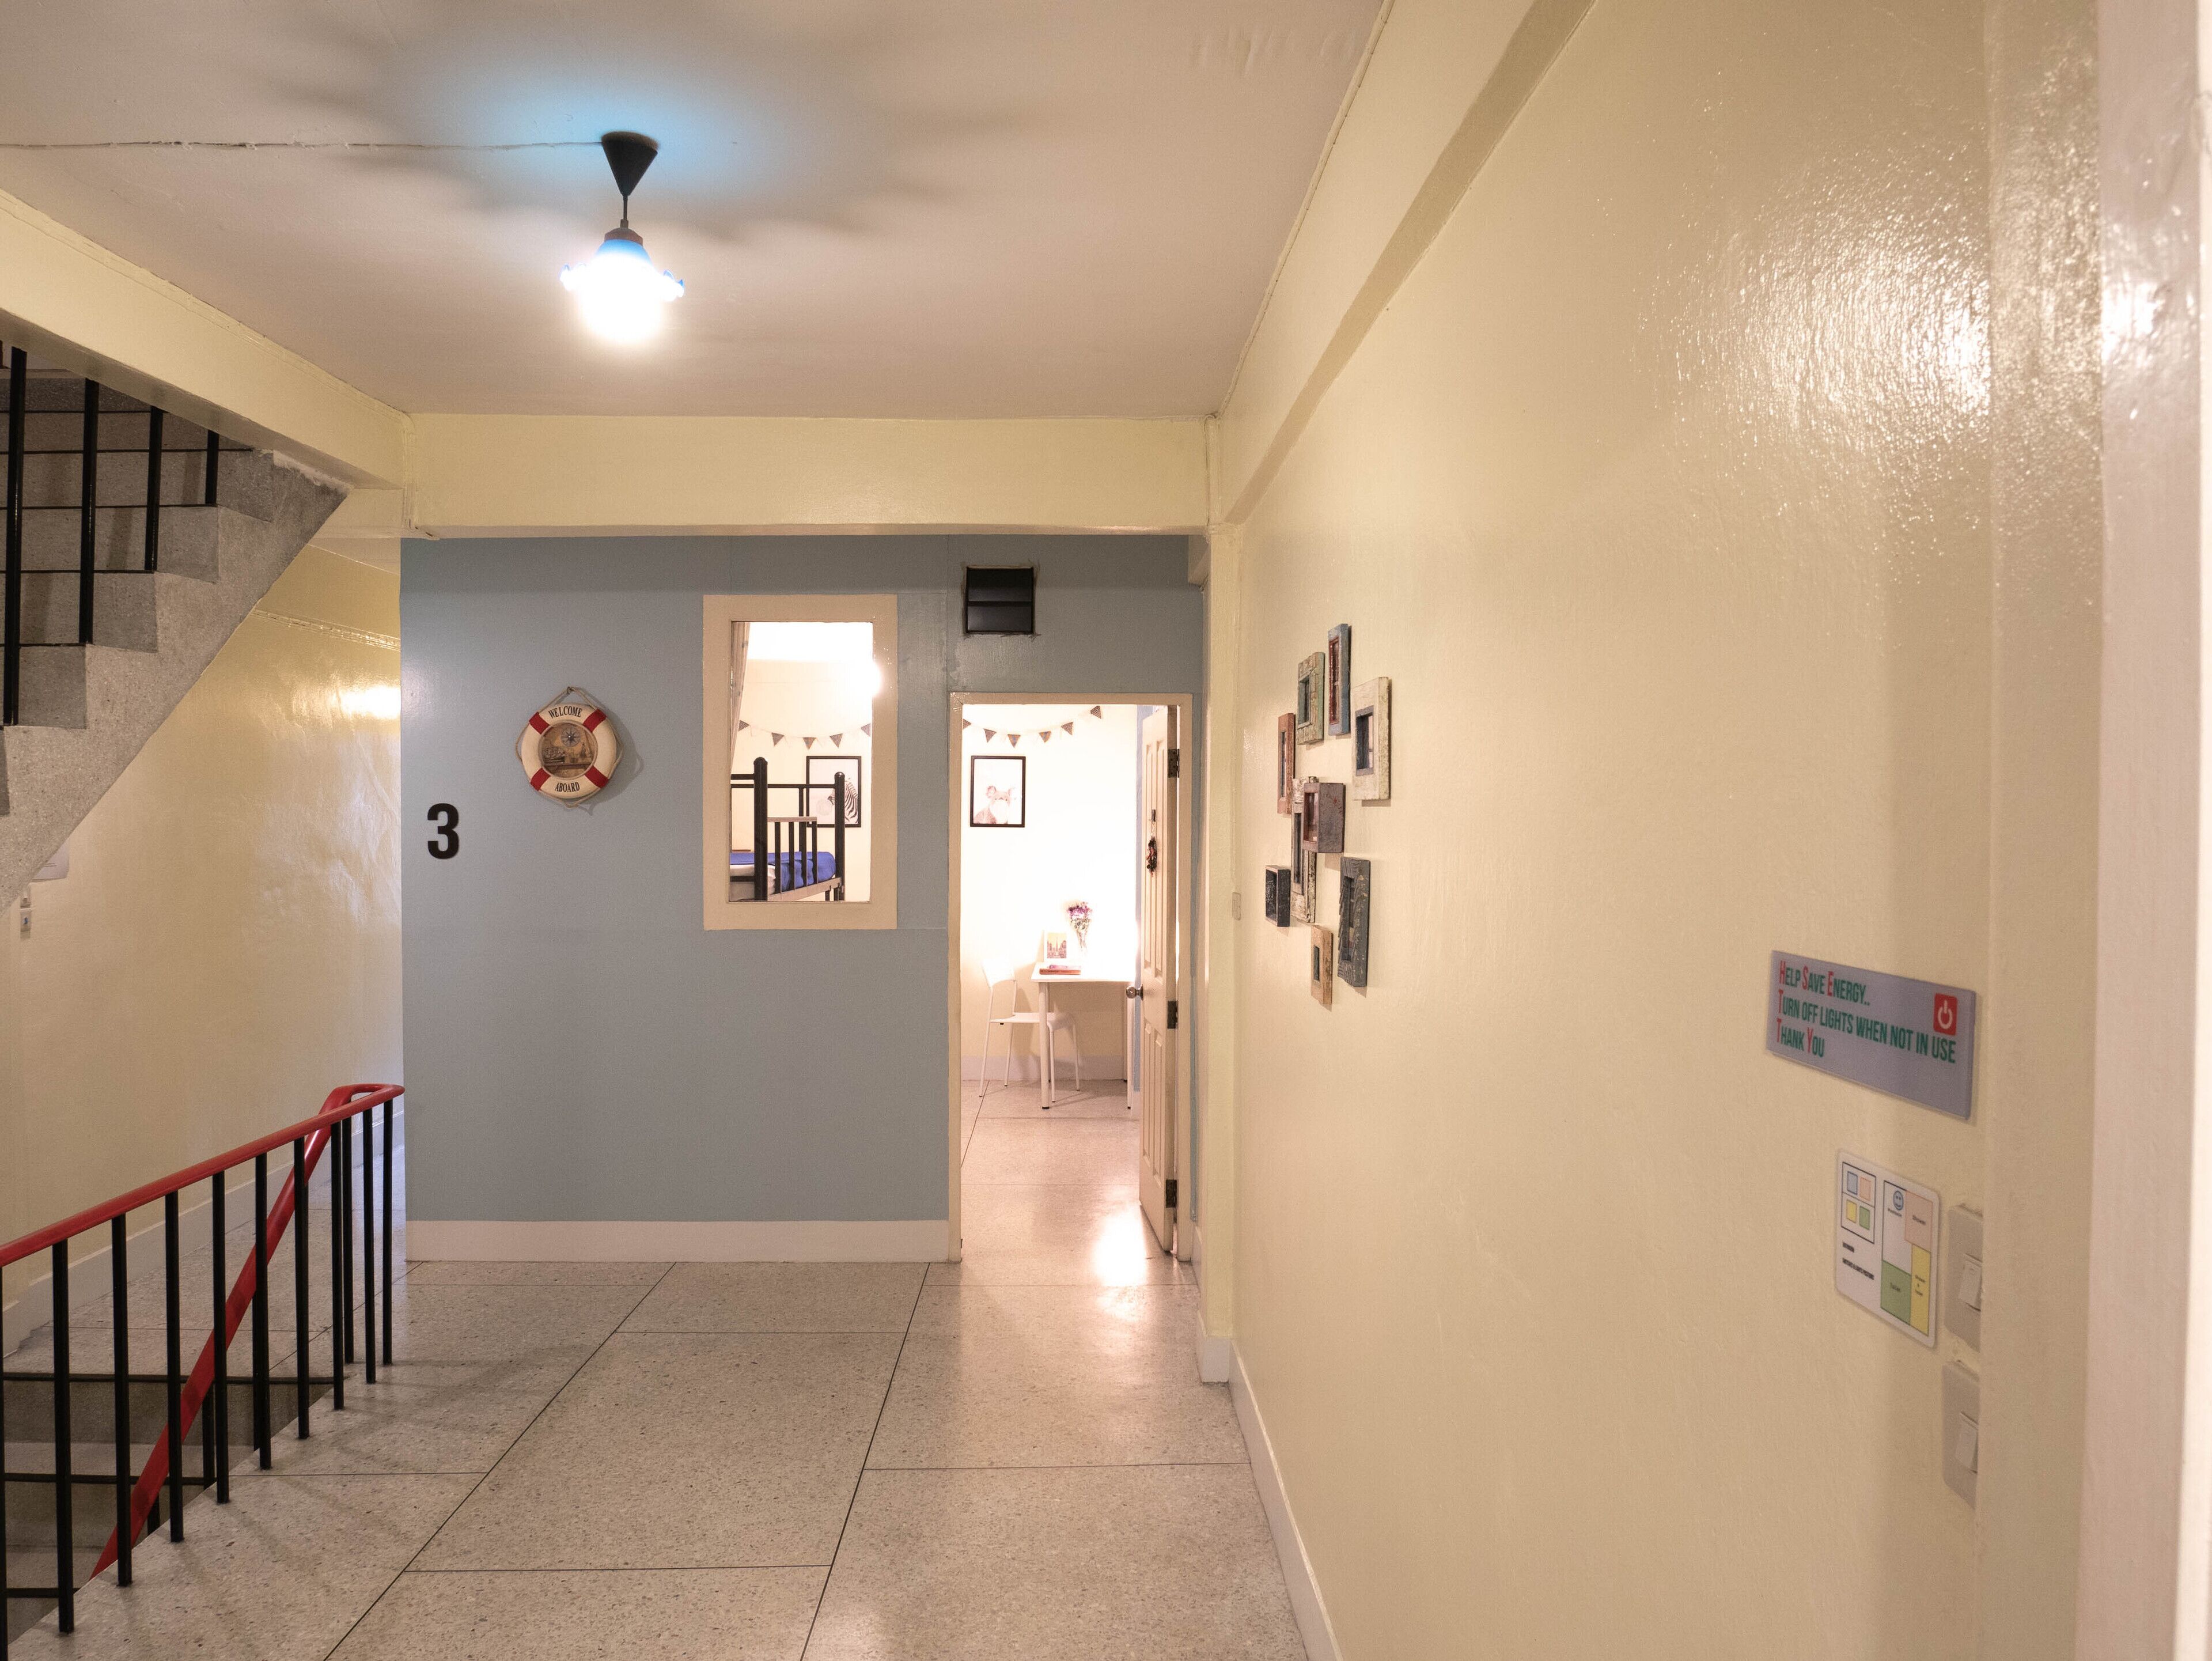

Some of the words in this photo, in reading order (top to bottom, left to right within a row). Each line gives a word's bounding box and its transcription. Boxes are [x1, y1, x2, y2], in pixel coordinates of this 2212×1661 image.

[548, 706, 582, 718] WELCOME
[555, 782, 580, 793] ABOARD
[427, 803, 459, 860] 3
[1779, 960, 1801, 985] HELP
[1802, 966, 1825, 995] SAVE
[1777, 1018, 1805, 1051] THANK
[1807, 1027, 1825, 1058] YOU
[1778, 989, 1800, 1019] TURN
[1801, 1001, 1819, 1023] OFF
[1820, 1007, 1854, 1034] LIGHTS
[1855, 1016, 1888, 1045] WHEN
[1890, 1024, 1914, 1051] NOT
[1915, 1031, 1929, 1056] IN
[1931, 1036, 1957, 1064] USE
